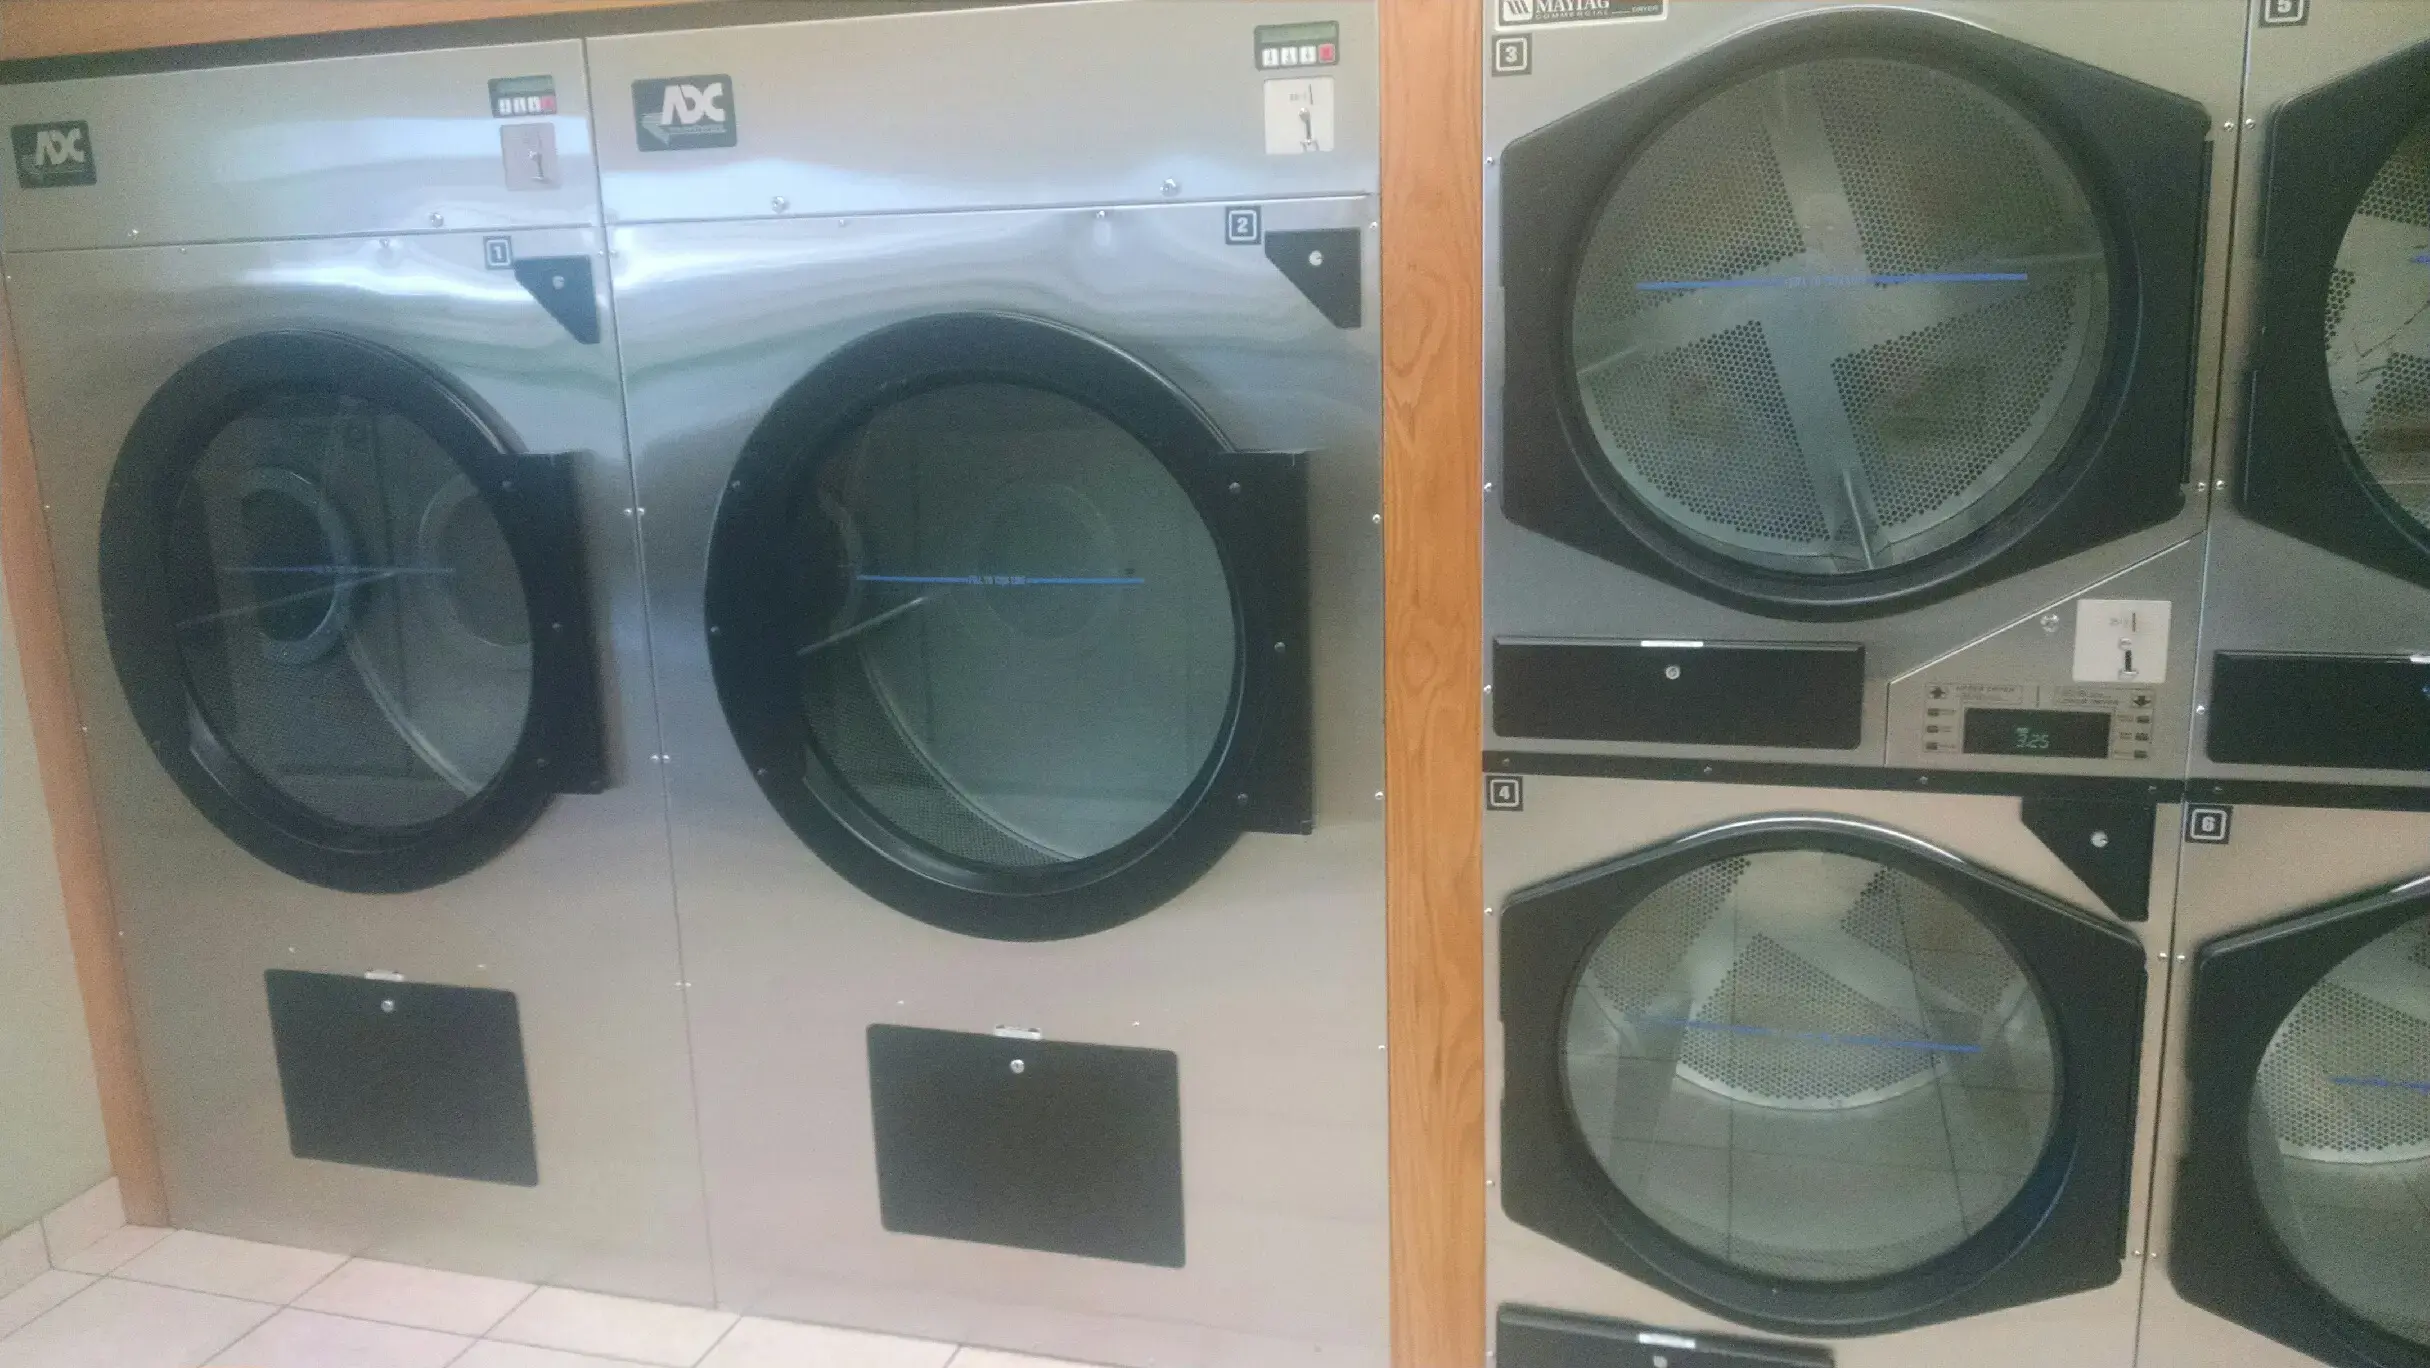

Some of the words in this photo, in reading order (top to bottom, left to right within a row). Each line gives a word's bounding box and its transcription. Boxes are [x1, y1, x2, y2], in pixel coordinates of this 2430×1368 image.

[1536, 10, 1609, 20] COMMERCIAL
[1505, 46, 1518, 63] 3
[661, 83, 726, 125] ADC
[35, 128, 84, 165] ADC
[1236, 217, 1249, 233] 2
[494, 246, 503, 260] 1
[1498, 785, 1511, 800] 4
[2202, 816, 2216, 832] 6
